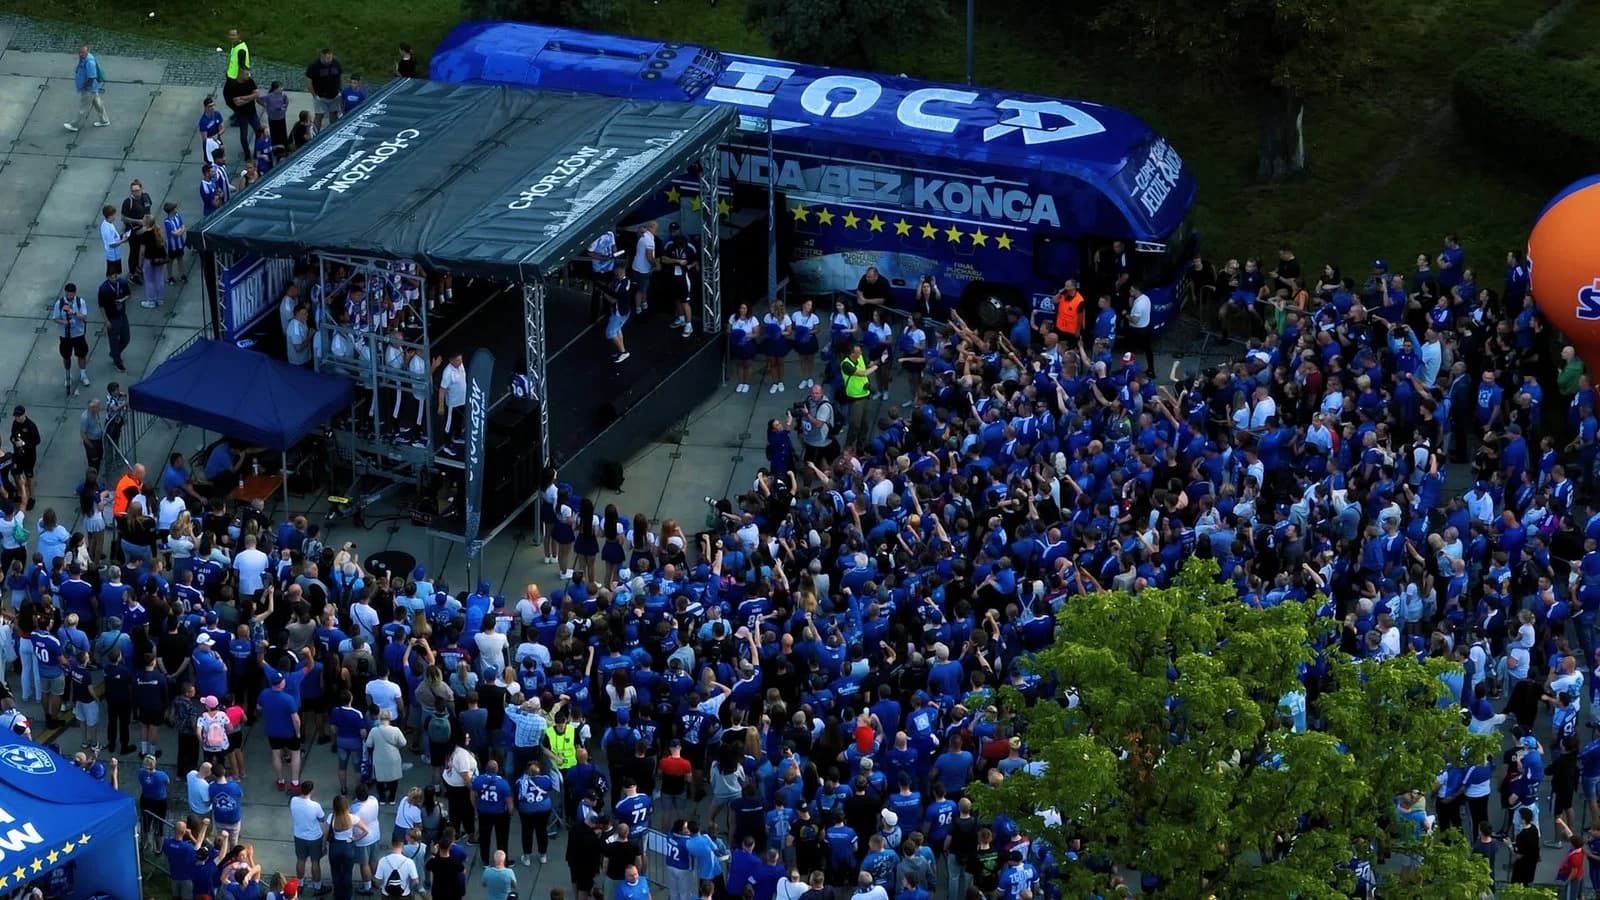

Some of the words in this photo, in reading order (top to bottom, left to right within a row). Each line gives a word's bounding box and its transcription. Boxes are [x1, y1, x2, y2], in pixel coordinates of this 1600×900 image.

[328, 128, 420, 194] CHORZÓW
[508, 145, 600, 210] CHORZÓW
[818, 164, 902, 204] BEZ
[914, 176, 1060, 227] KOŃCA
[1140, 173, 1171, 217] JEDZIE
[511, 383, 523, 397] 10
[197, 574, 205, 585] 9
[631, 808, 647, 824] 77
[938, 812, 953, 826] 96
